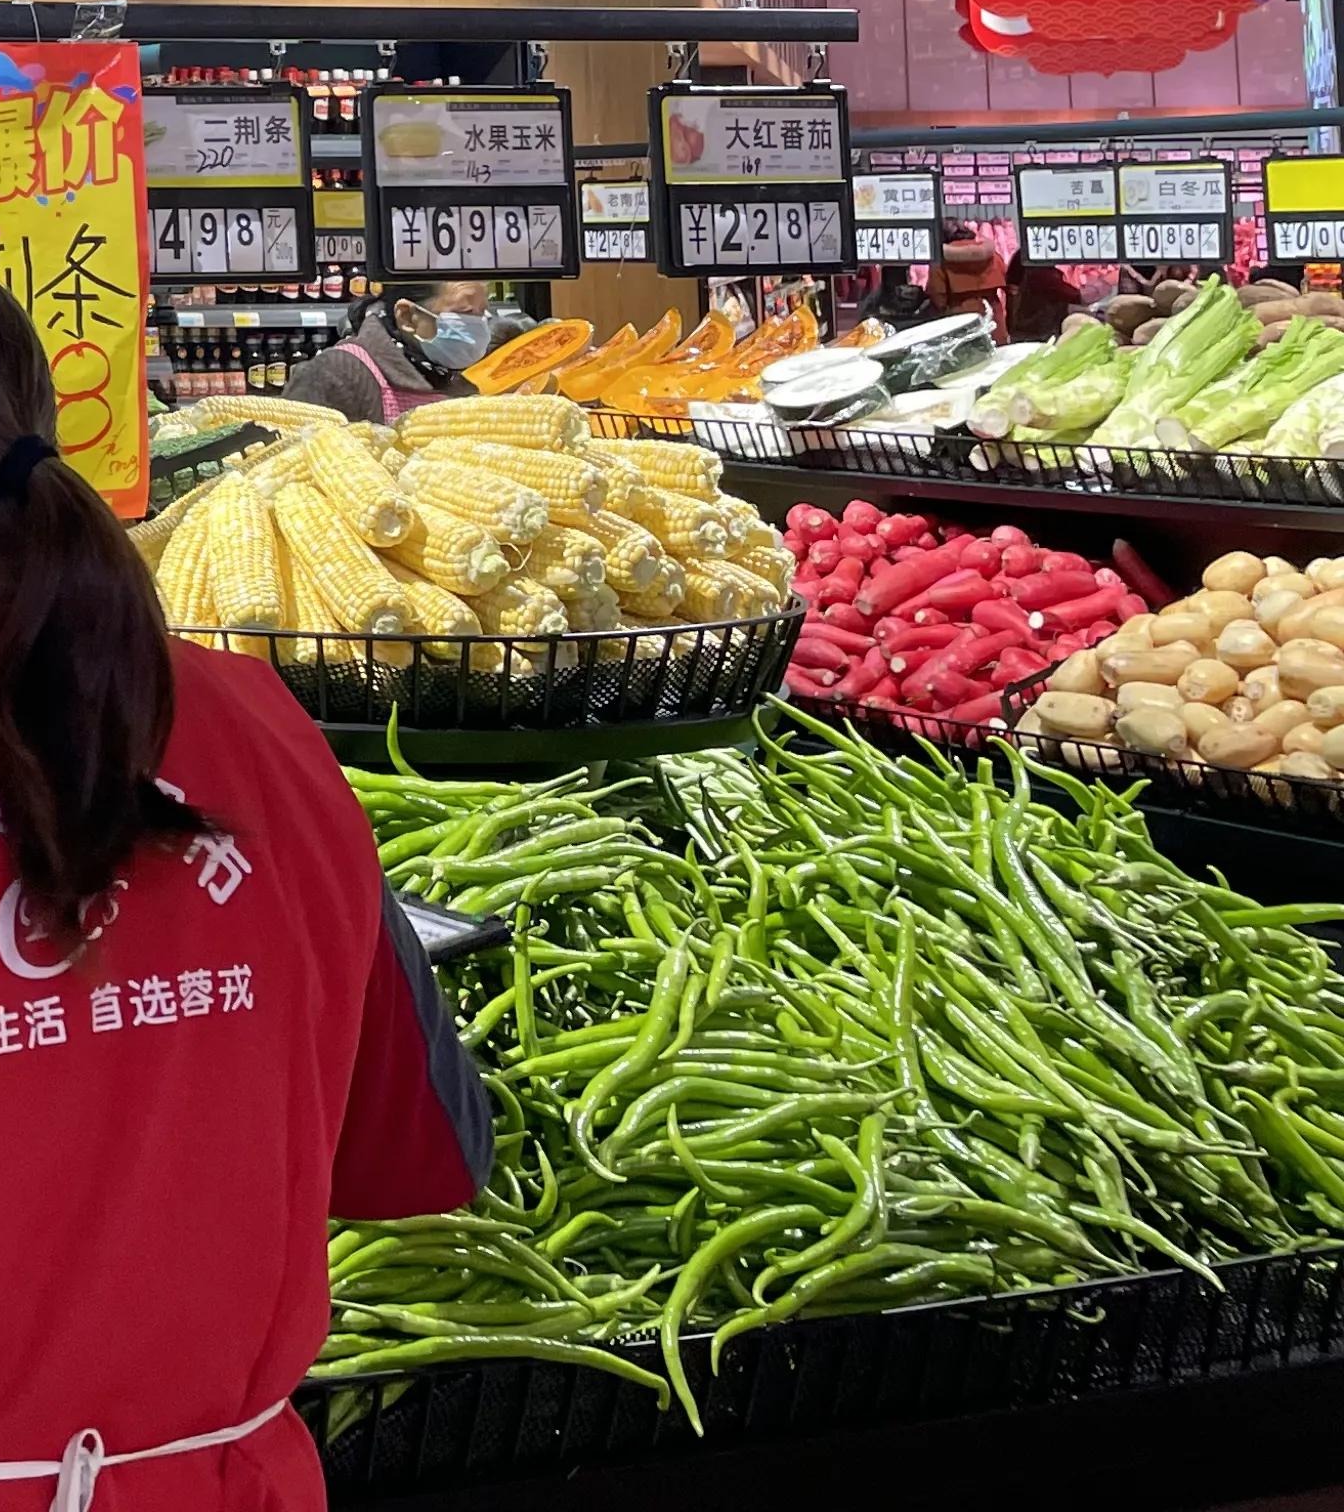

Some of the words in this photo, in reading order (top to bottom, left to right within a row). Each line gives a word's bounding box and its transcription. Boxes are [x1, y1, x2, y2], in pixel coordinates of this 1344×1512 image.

[204, 116, 292, 145] 二荆条
[464, 123, 556, 152] 水果玉米
[725, 118, 832, 151] 大红番茄
[1159, 180, 1223, 196] 白冬瓜
[89, 963, 254, 1034] 首选蓉戎
